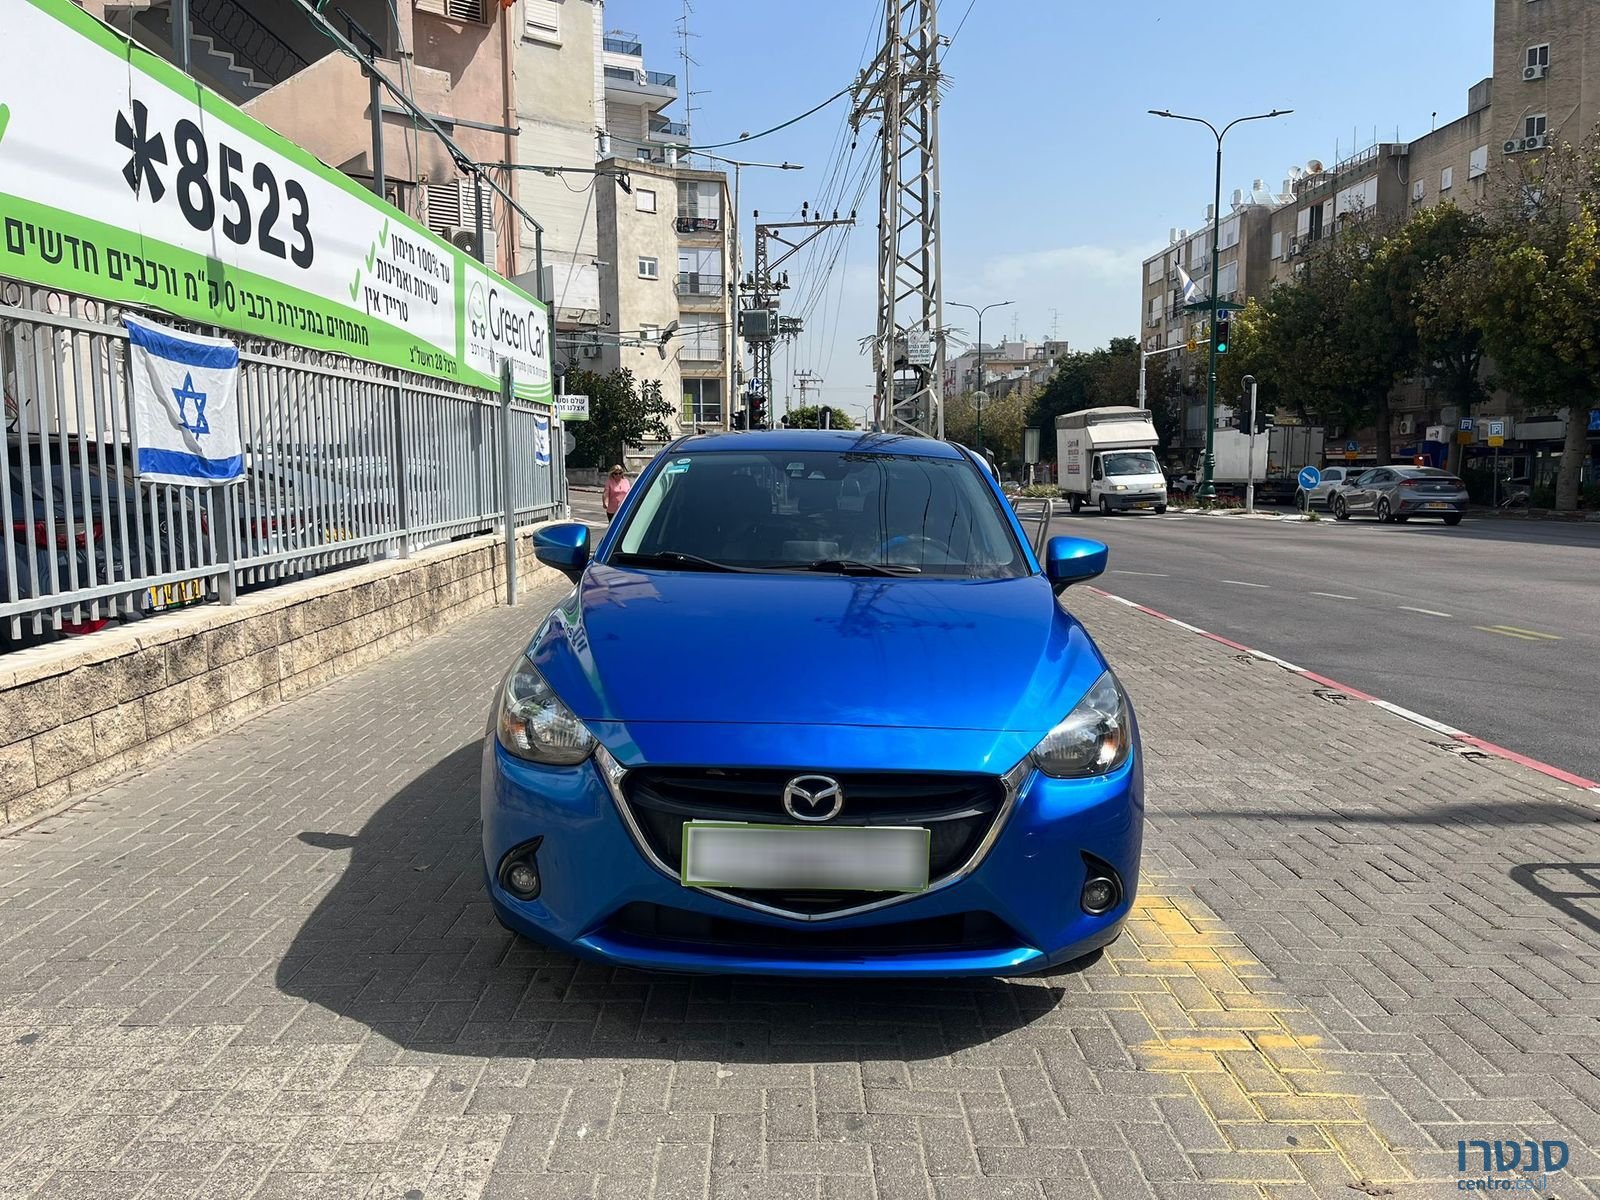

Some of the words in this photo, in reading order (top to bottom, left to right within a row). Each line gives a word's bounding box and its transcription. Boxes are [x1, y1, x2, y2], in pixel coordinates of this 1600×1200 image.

[5, 217, 99, 275] חדשים
[391, 234, 415, 265] מימון
[107, 248, 178, 296] ורכבים
[376, 258, 413, 294] ואמינות
[417, 247, 440, 278] 100%
[440, 263, 450, 284] עד
[240, 290, 274, 322] רכבי
[364, 286, 381, 315] אין
[414, 277, 438, 305] שירות
[277, 301, 324, 335] במכירת
[382, 293, 409, 322] טרייד
[328, 315, 369, 346] מתמחים
[489, 288, 527, 352] Green
[528, 310, 545, 359] Car
[434, 354, 443, 371] 28
[443, 355, 457, 375] הרצל
[570, 397, 585, 405] שלם
